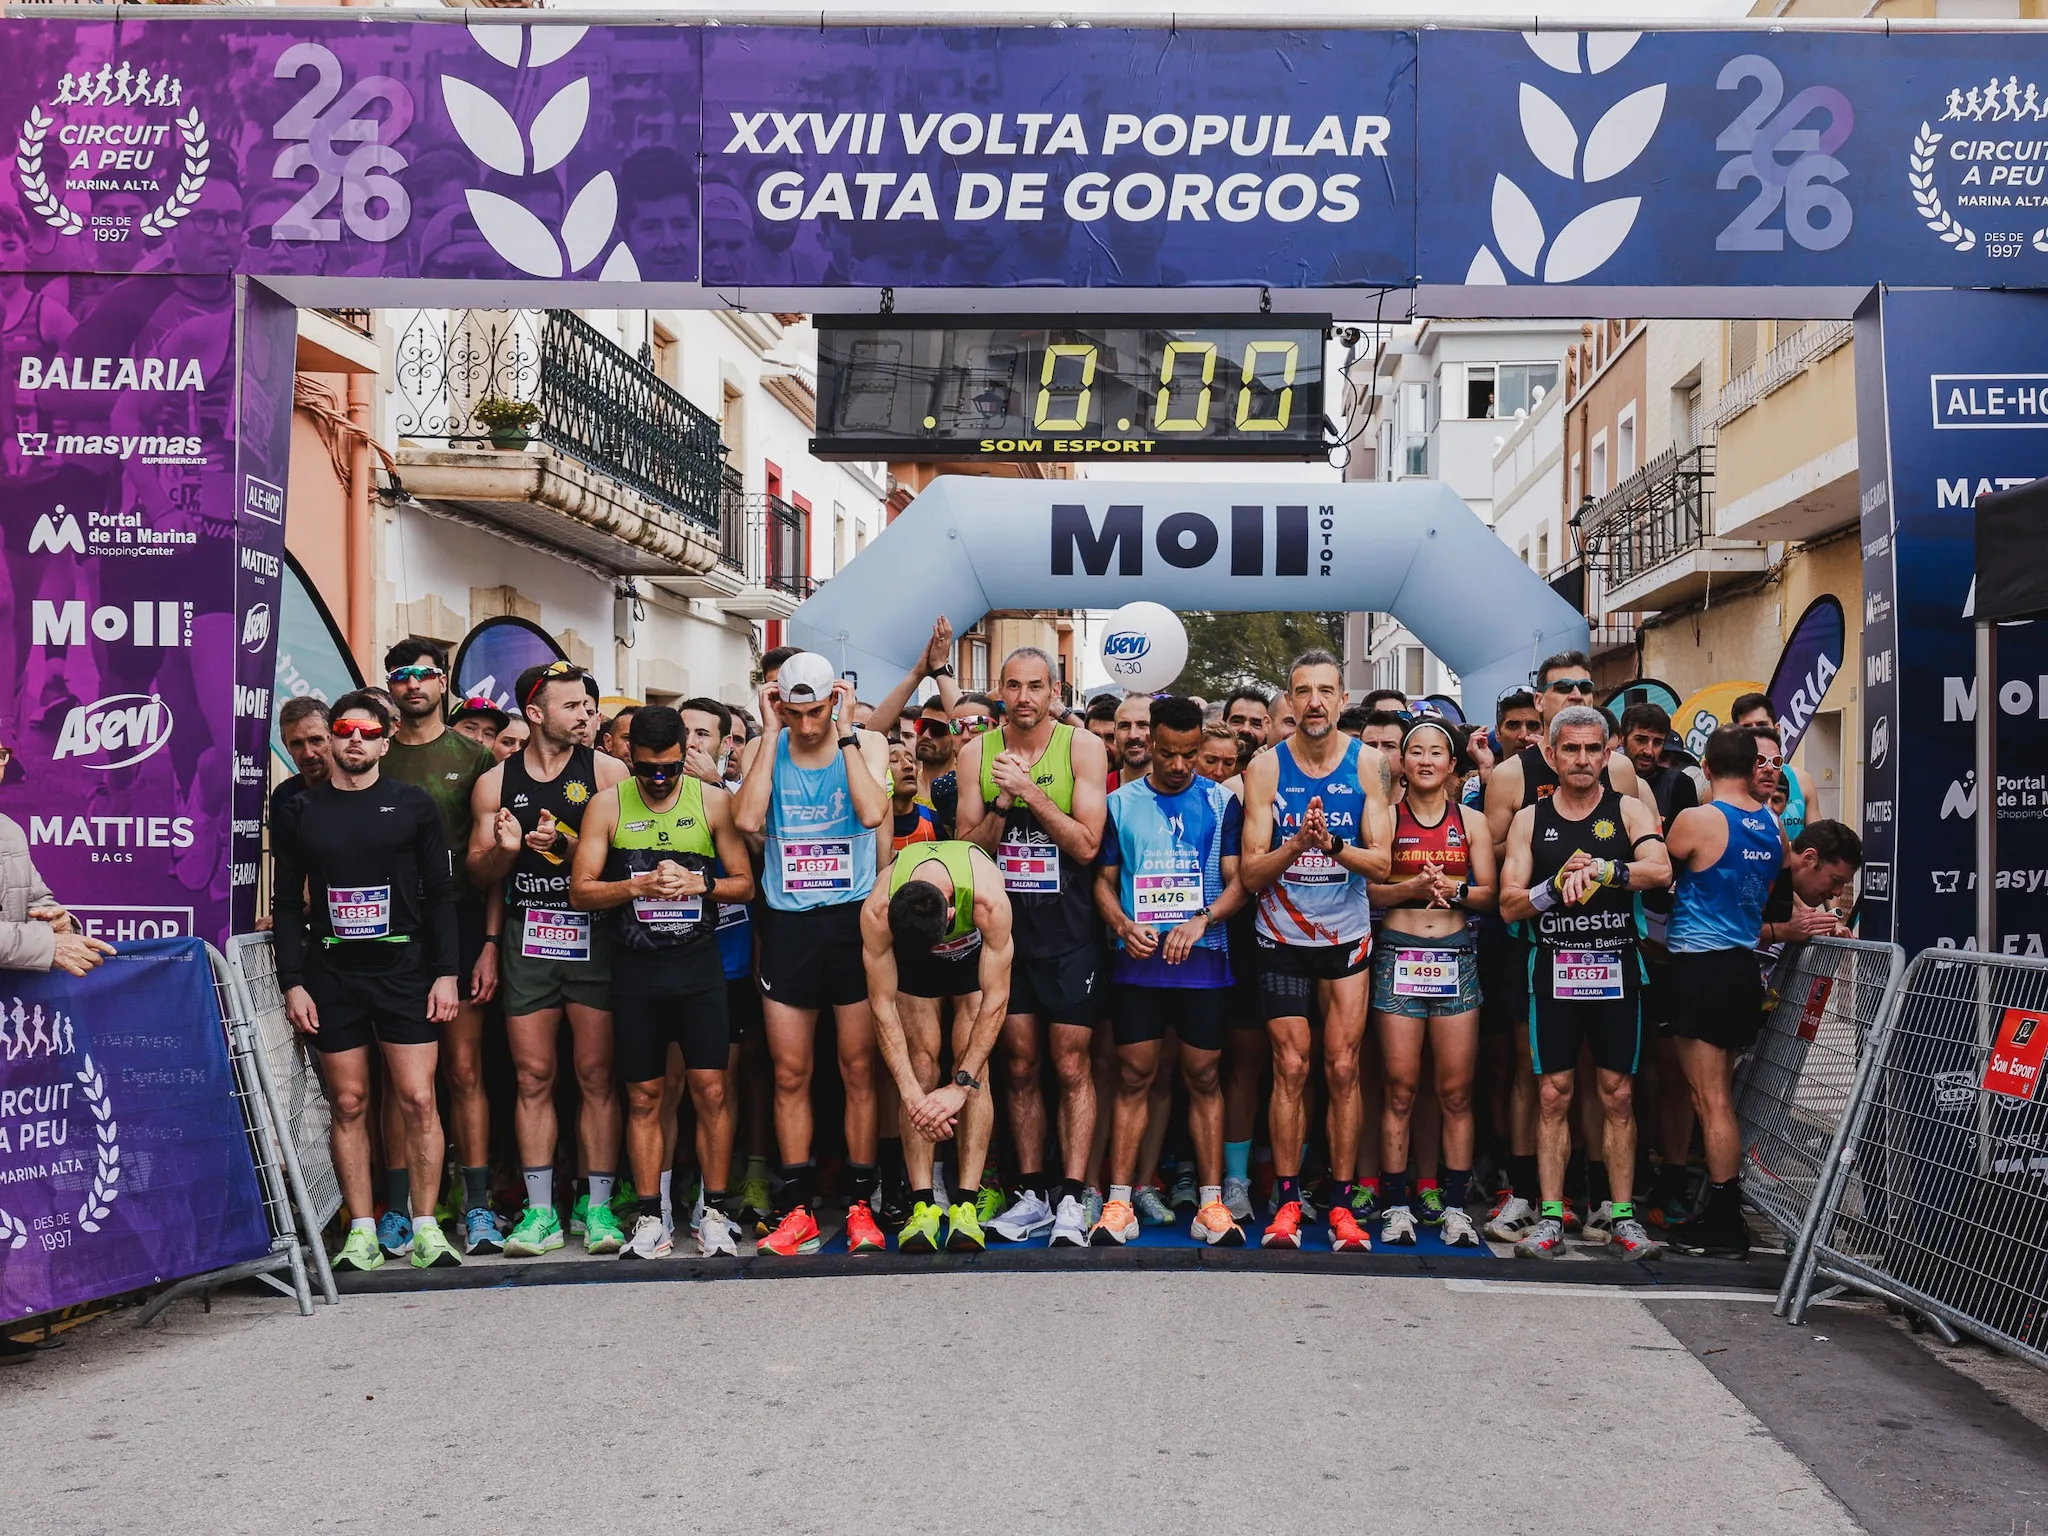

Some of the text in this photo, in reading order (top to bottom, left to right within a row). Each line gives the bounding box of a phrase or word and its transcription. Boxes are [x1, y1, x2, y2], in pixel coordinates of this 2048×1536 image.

[59, 125, 170, 145] CIRCUIT
[722, 112, 1391, 157] XXVII VOLTA POPULAR
[69, 150, 154, 170] A PEU
[1949, 141, 2048, 162] CIRCUI
[1961, 165, 2045, 187] A PEU
[66, 179, 160, 191] MARINA ALTA
[757, 171, 1361, 222] GATA DE GORGOS
[1958, 195, 2048, 207] MARINA ALTA
[91, 217, 132, 226] DES DE
[92, 228, 130, 242] 1997
[1984, 232, 2024, 242] DES DE
[1985, 244, 2022, 258] 1997
[1947, 387, 2048, 416] ALE-HO
[55, 434, 203, 460] masymas
[980, 438, 1156, 453] SOM ESPORT
[141, 457, 208, 465] SUPERMERCATS
[248, 486, 280, 514] ALE-HOP
[87, 512, 141, 527] Portal
[88, 528, 197, 544] de la Marina
[1051, 504, 1309, 577] Moll
[1318, 504, 1335, 577] MOTOR
[88, 545, 174, 557] ShoppingCenter
[241, 547, 279, 578] MATTIES
[32, 599, 179, 647] Moll
[183, 601, 194, 647] MOTOR
[1104, 632, 1148, 657] Asevi
[1114, 661, 1142, 675] 4:30
[53, 693, 162, 760] Asevi
[1996, 775, 2046, 791] Portal
[1997, 792, 2017, 806] de
[2022, 792, 2036, 806] la
[1866, 801, 1892, 823] MATTIES
[1997, 808, 2048, 820] ShoppingC
[29, 815, 195, 848] MATTIES
[91, 852, 134, 863] BAGS
[1143, 858, 1201, 870] ondara
[1394, 849, 1466, 863] KAMIKAZES
[800, 860, 835, 872] 1697
[1020, 862, 1030, 872] 2
[515, 872, 571, 893] Gine
[1150, 892, 1185, 903] 1476
[340, 906, 377, 919] 1682
[86, 918, 180, 943] E-HOP
[1539, 910, 1631, 934] Ginestar
[538, 928, 575, 941] 1680
[1414, 966, 1442, 977] 499
[1571, 968, 1605, 980] 1667
[0, 1082, 73, 1118] RCUIT
[20, 1119, 67, 1151] PEU
[51, 1158, 84, 1175] ALTA
[33, 1212, 71, 1230] DES DE
[39, 1229, 72, 1251] 1997
